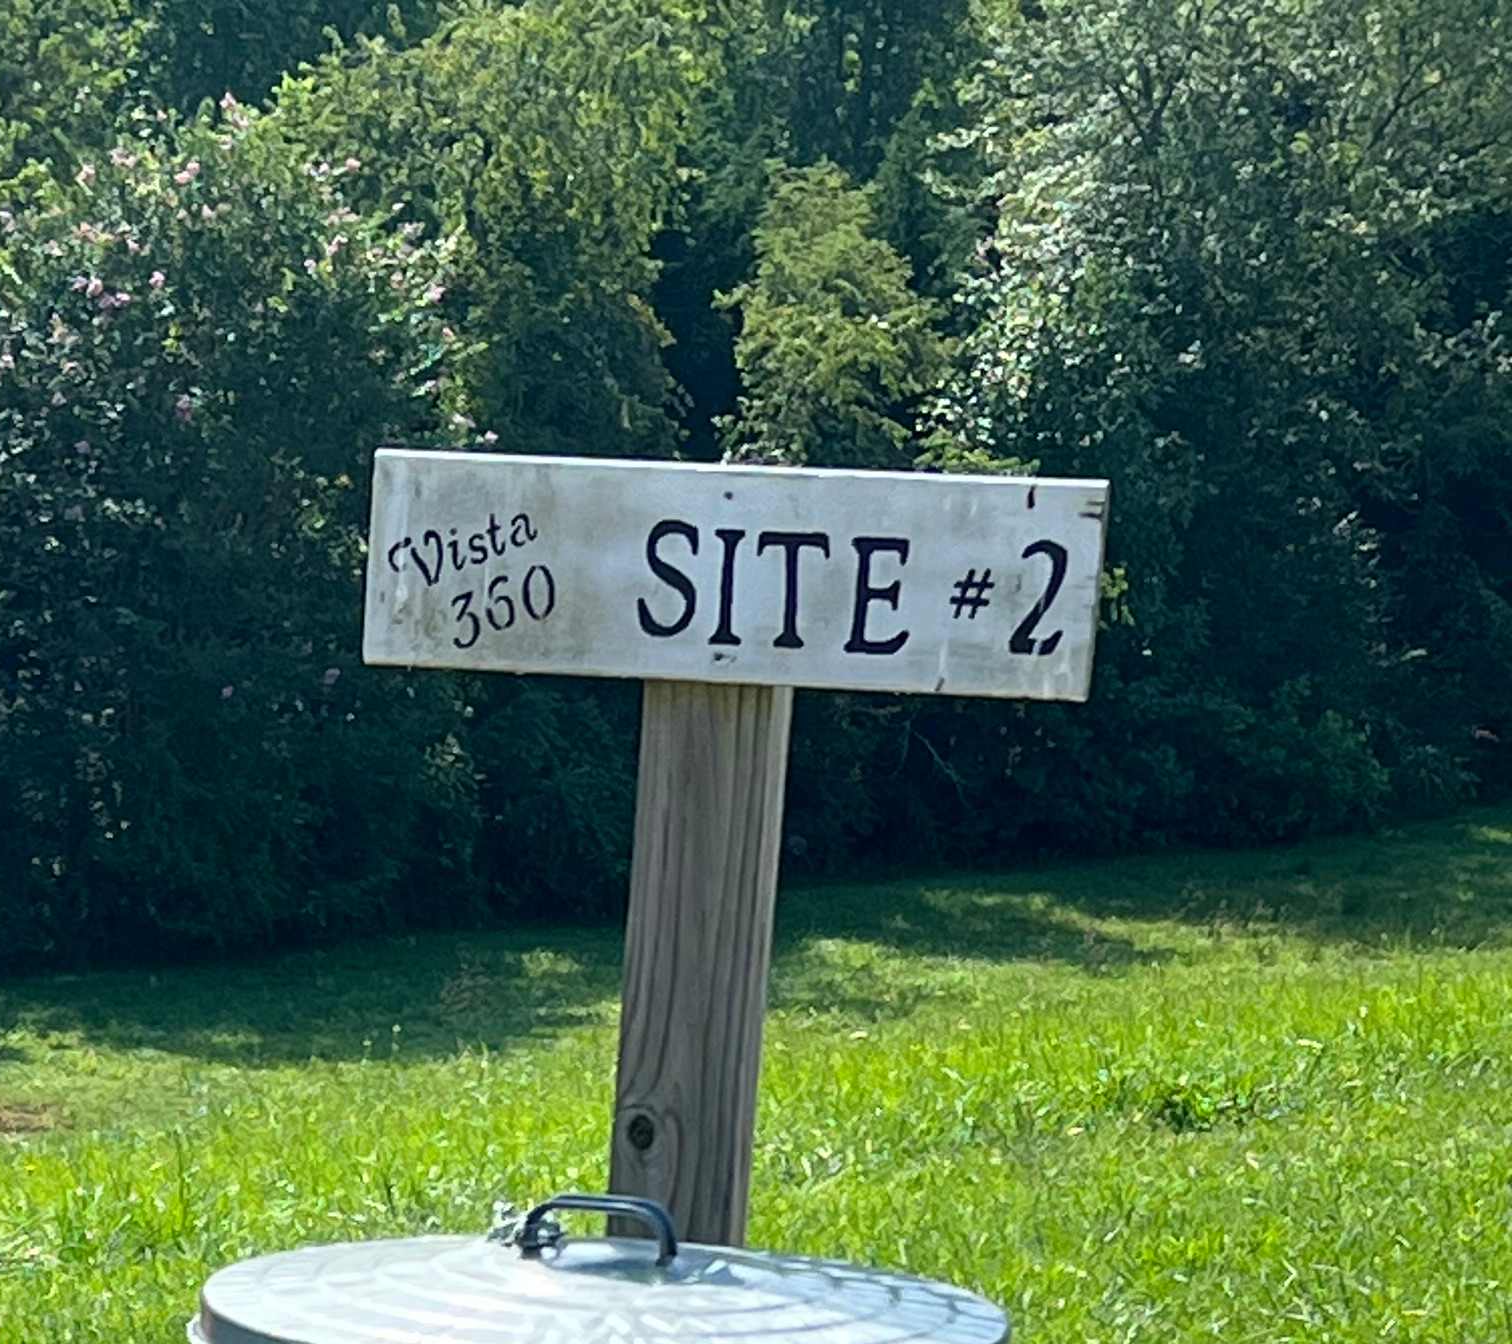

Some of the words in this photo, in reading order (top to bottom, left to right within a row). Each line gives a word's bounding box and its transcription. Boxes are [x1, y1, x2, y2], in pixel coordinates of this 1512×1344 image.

[387, 512, 538, 587] Vista
[636, 519, 911, 655] SITE
[1008, 540, 1070, 656] 2
[450, 564, 556, 649] 360
